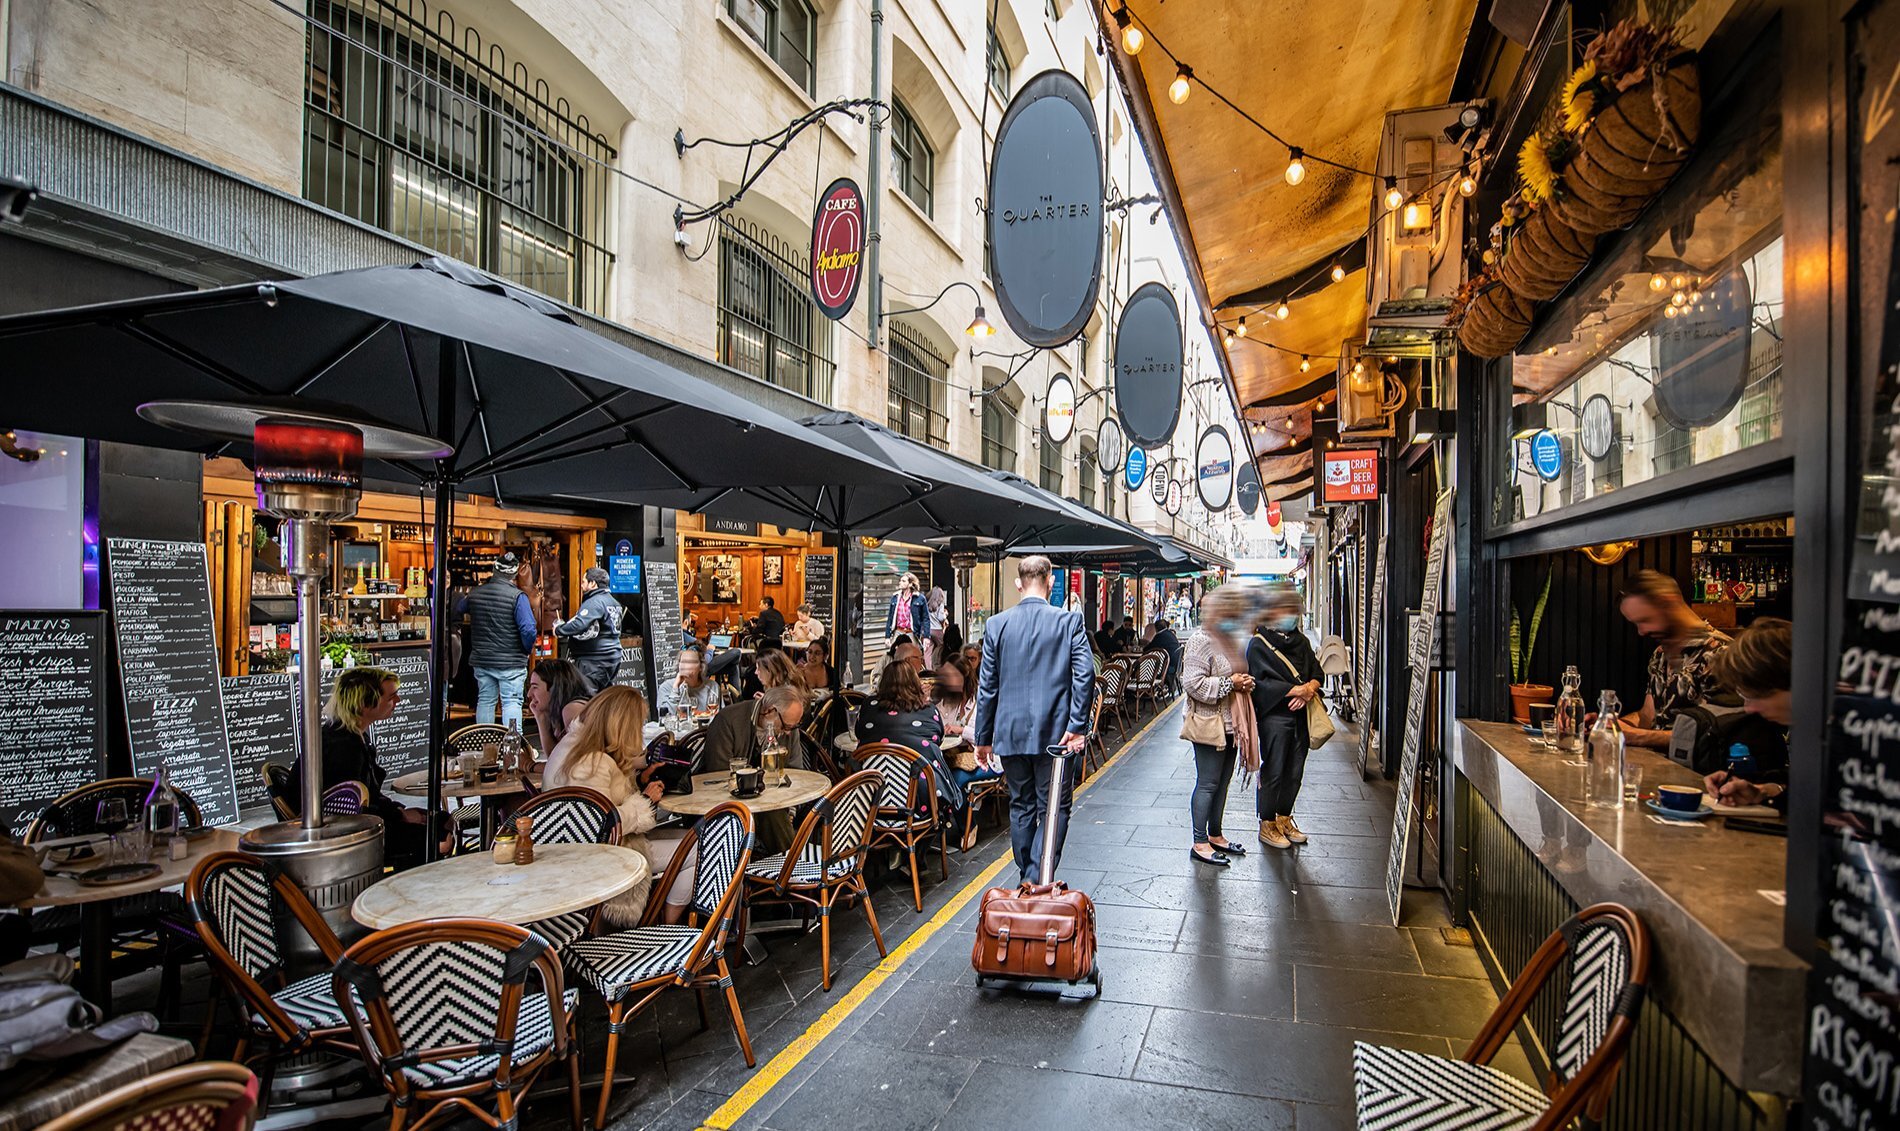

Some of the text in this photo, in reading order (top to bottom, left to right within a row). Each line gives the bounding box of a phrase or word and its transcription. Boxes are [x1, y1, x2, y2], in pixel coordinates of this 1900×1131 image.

[825, 194, 857, 211] CAFÉ
[1003, 203, 1090, 226] QUARTER
[816, 248, 859, 276] Andiamo
[1123, 363, 1176, 375] QUARTER
[1351, 459, 1373, 469] CRAFT
[1354, 472, 1372, 482] BEER
[1350, 484, 1376, 495] ON TAP
[715, 520, 748, 531] ANDIAMO
[110, 540, 150, 550] LUNCH
[166, 543, 206, 553] DINNER
[5, 619, 72, 630] MAINS
[52, 630, 86, 645] Chips
[123, 646, 158, 655] CARBONARA
[36, 656, 73, 671] Chips
[124, 661, 156, 669] ORTOLANA
[380, 656, 422, 664] DESSERTS
[0, 679, 76, 692] Beef Burger
[222, 676, 238, 687] STA
[250, 674, 290, 685] RISOTTO
[128, 686, 170, 696] PESCATORE
[252, 690, 283, 698] BASILICO
[153, 697, 198, 709] PIZZA
[0, 706, 32, 718] hicken
[0, 730, 71, 741] Pollo Andiamo
[229, 728, 259, 739] OGNESE
[158, 738, 200, 751] Vegetarian
[376, 735, 399, 745] POLLO
[242, 744, 270, 755] PANNA
[0, 751, 26, 762] hicken
[56, 768, 83, 780] Steak
